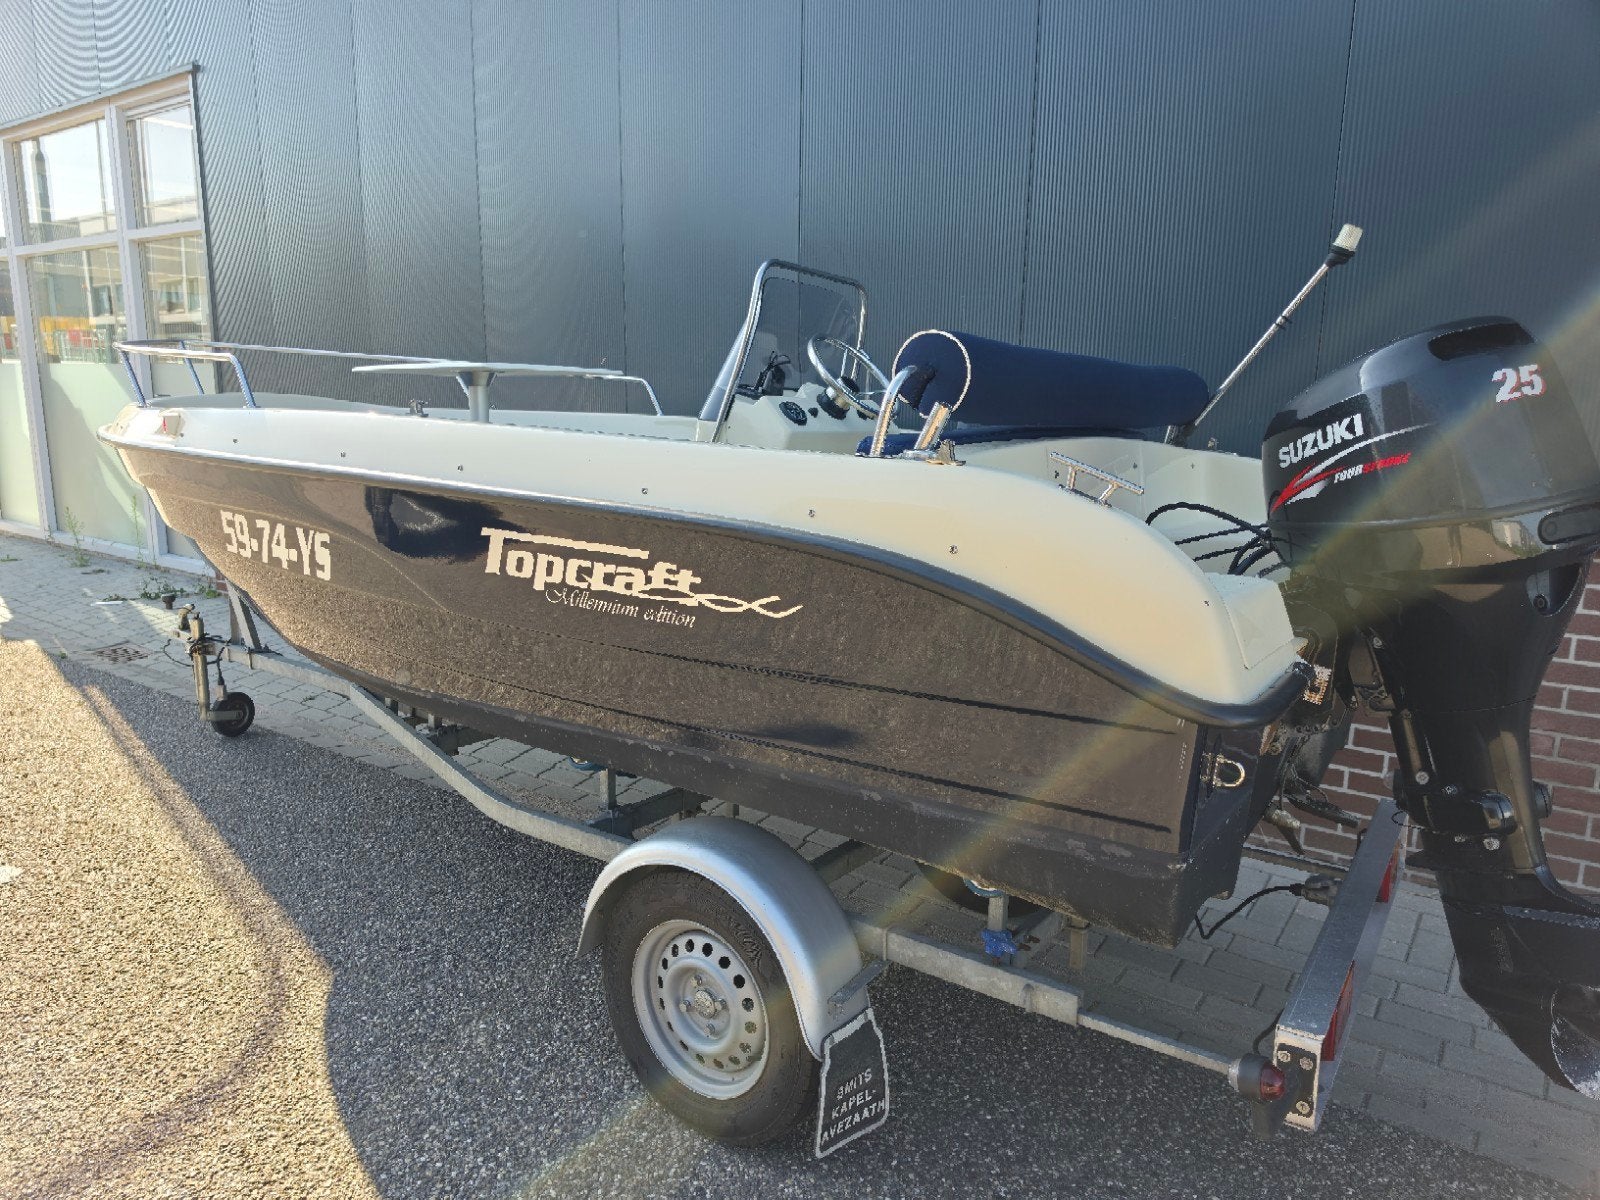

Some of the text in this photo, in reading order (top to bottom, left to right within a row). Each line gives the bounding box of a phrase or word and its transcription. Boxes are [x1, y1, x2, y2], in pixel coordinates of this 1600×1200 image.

[1491, 364, 1547, 404] 25
[1278, 412, 1364, 469] SUZUKI
[219, 509, 332, 581] 59-74-YS
[480, 526, 703, 607] Topcraft
[643, 605, 696, 629] edition
[820, 1097, 886, 1147] AVEZAATH
[831, 1089, 877, 1120] KAPEL-
